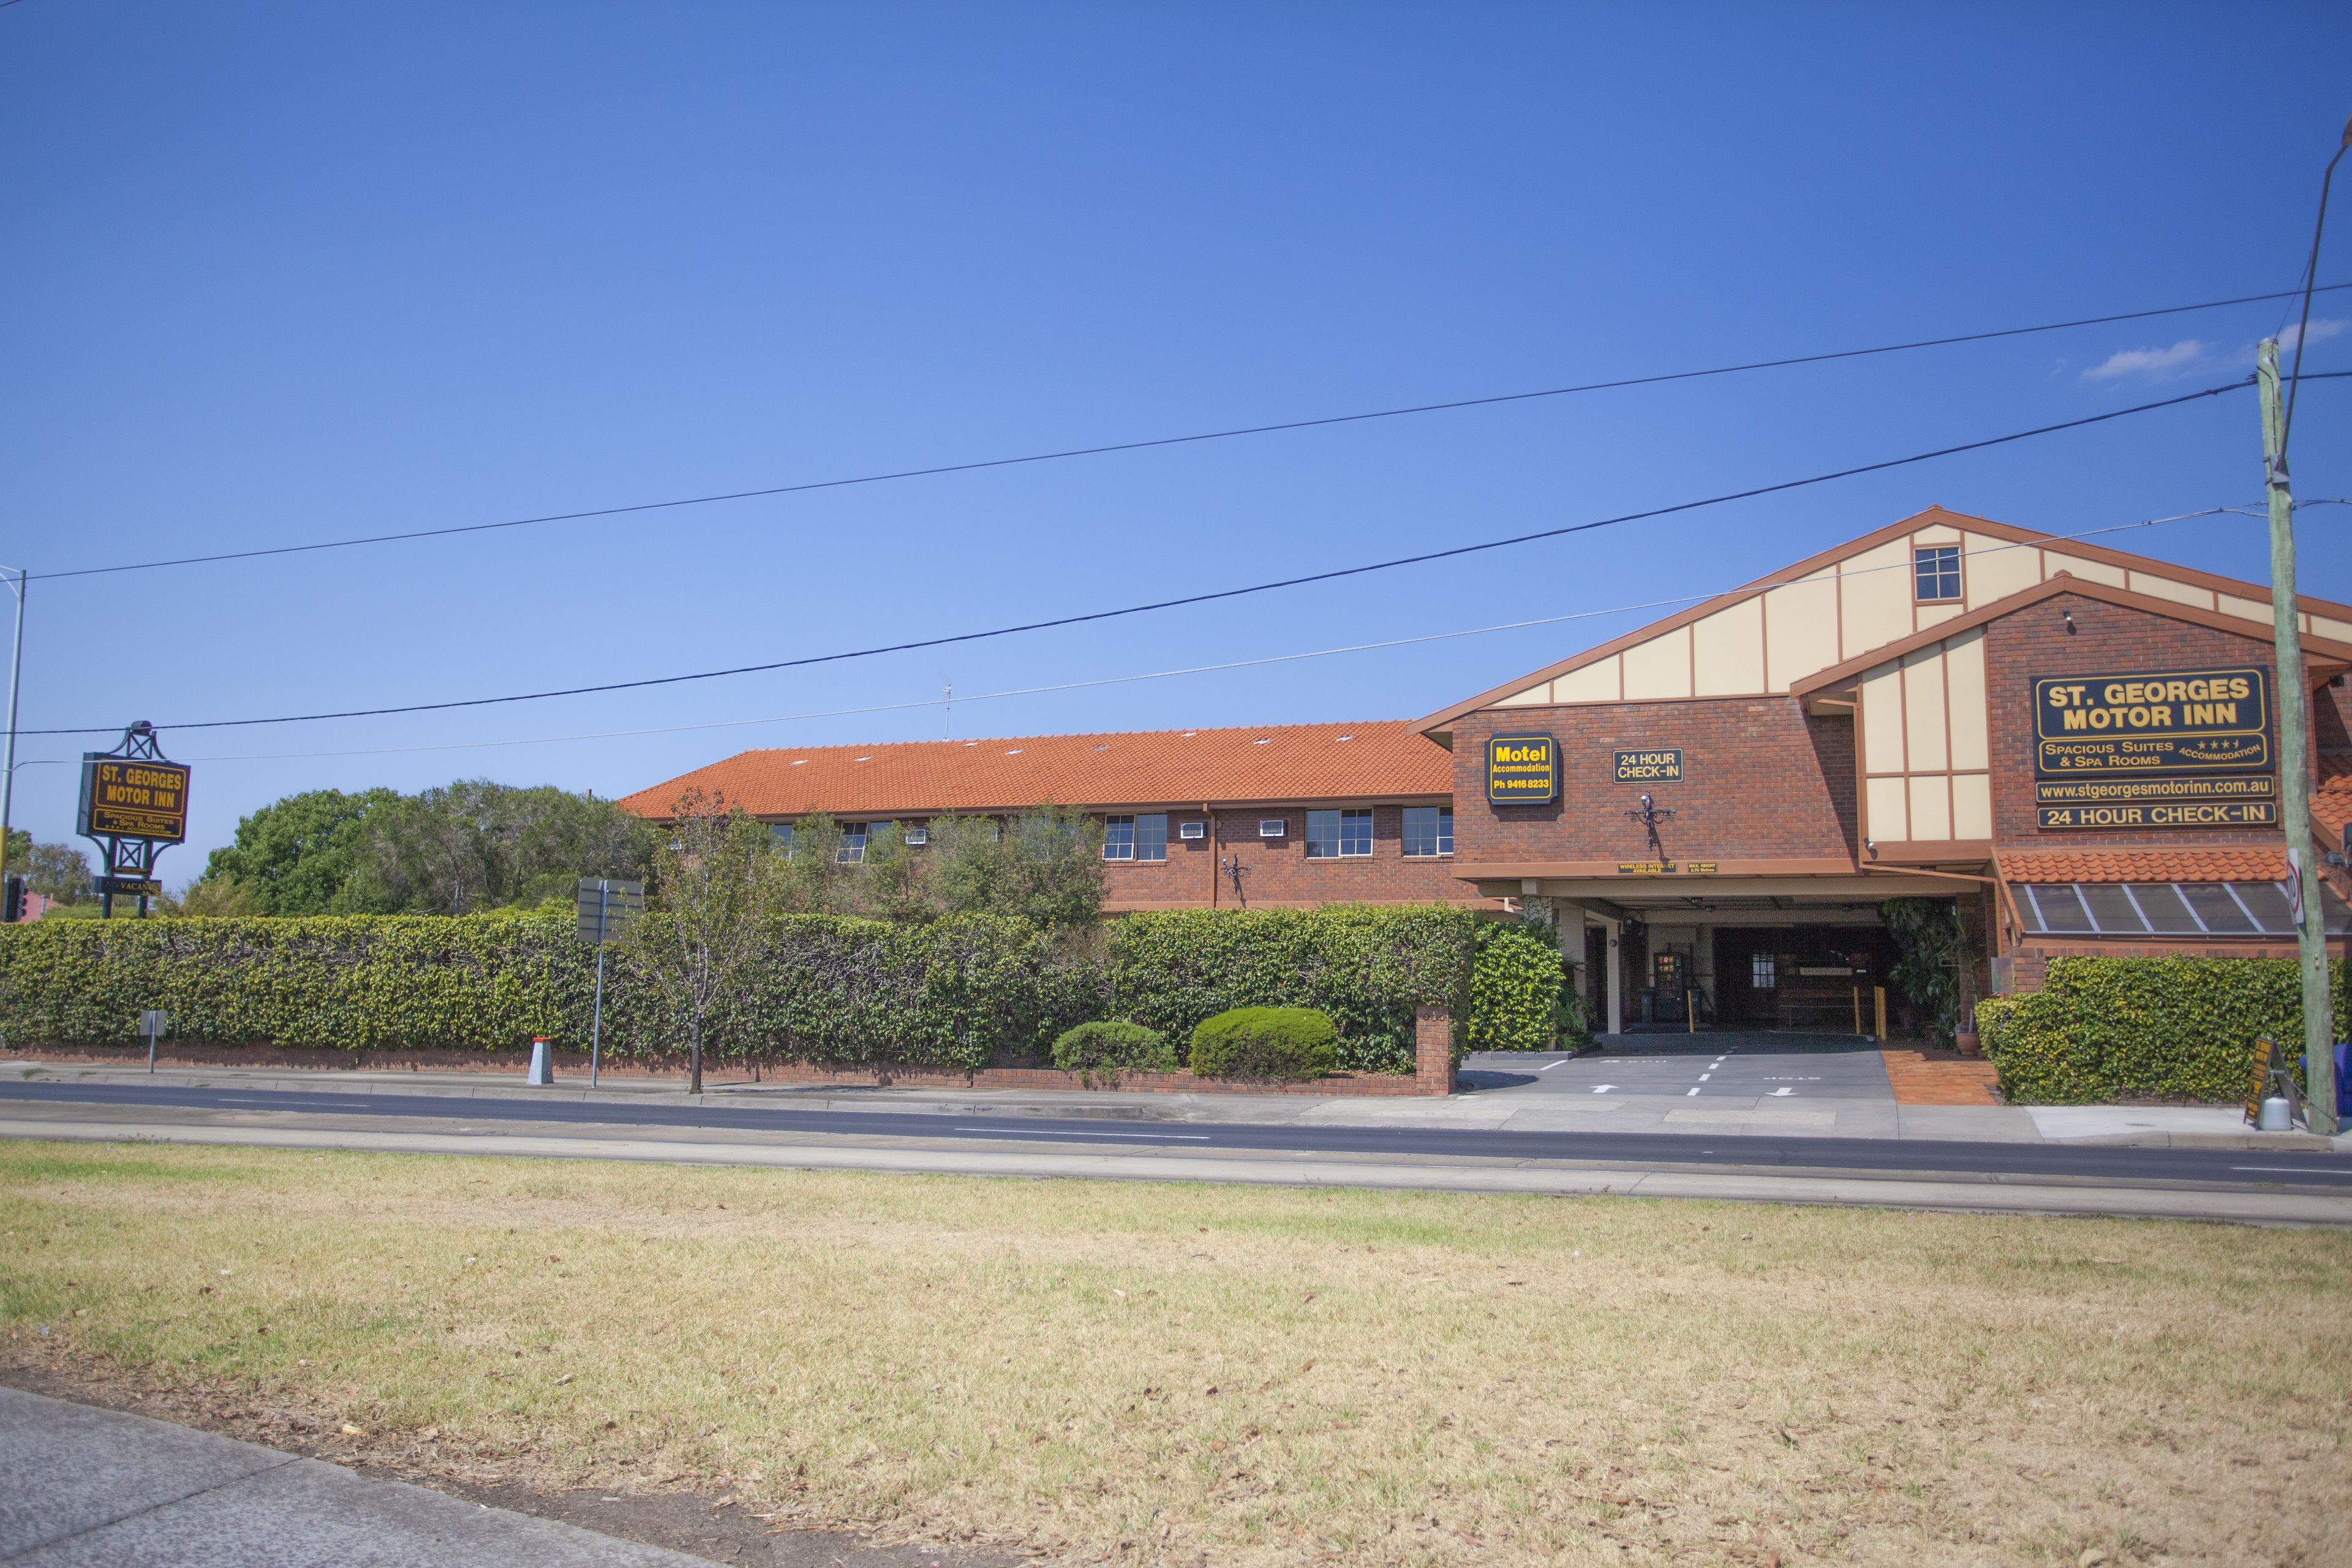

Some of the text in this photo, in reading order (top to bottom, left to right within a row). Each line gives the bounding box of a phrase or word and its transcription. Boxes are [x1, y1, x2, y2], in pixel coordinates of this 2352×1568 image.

[2049, 678, 2250, 707] ST. GEORGES
[2064, 703, 2237, 729] MOTOR INN
[1496, 746, 1545, 761] Motel
[2045, 742, 2174, 755] SPACIOUS SUITES
[2179, 744, 2261, 760] ACCOMMODATION
[1621, 753, 1675, 765] 24 HOUR
[2060, 755, 2160, 767] & SPA ROOMS
[1493, 763, 1550, 772] Accommodation
[1618, 766, 1679, 778] CHECK-IN
[102, 765, 181, 790] ST. GEORGES
[1507, 780, 1527, 788] 9416
[1528, 779, 1549, 788] 8233
[107, 785, 175, 807] MOTOR INN
[2041, 780, 2269, 799] www.stgeorgesmotorinn.com.au
[104, 812, 173, 824] SPACIOUS SUITES
[2048, 806, 2265, 824] 24 HOUR CHECK-IN
[138, 821, 165, 830] ROOMS
